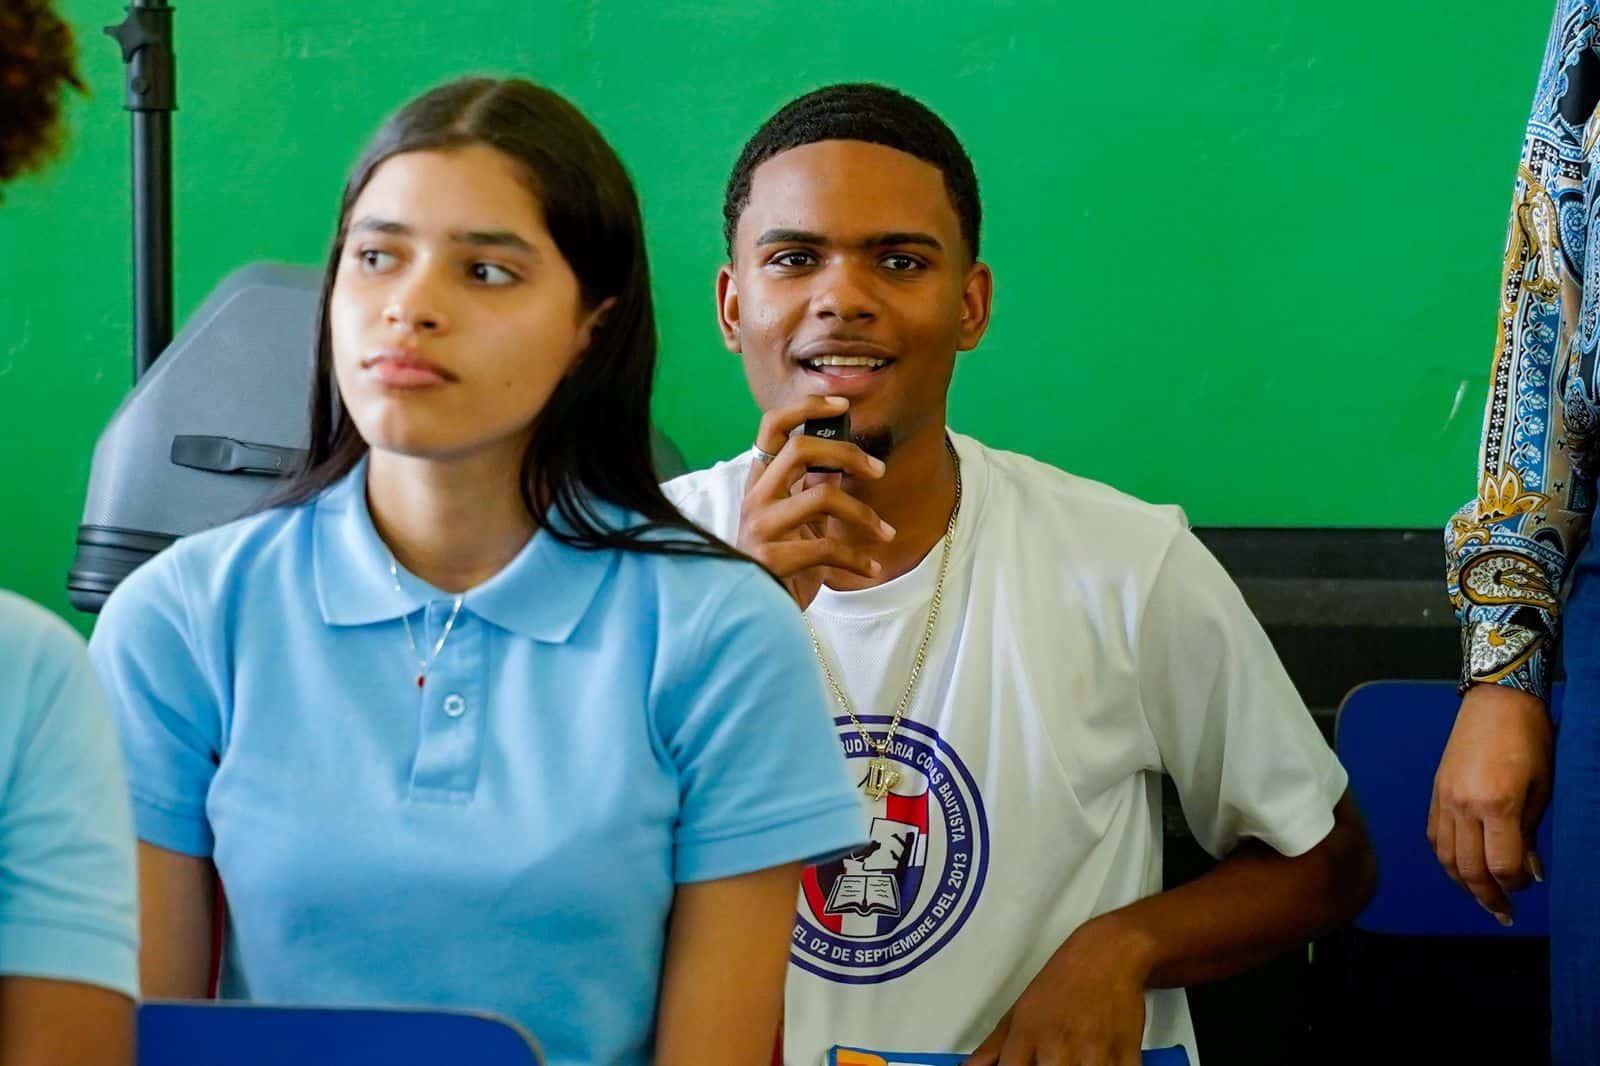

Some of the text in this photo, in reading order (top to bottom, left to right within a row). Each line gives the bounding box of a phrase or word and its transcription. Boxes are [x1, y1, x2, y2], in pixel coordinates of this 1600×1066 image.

[938, 782, 966, 843] BAUTISTA
[809, 937, 830, 956] 02
[831, 945, 852, 961] DE
[854, 915, 937, 963] SEPTIEMBRE
[931, 892, 957, 919] DEL
[948, 852, 968, 889] 2013
